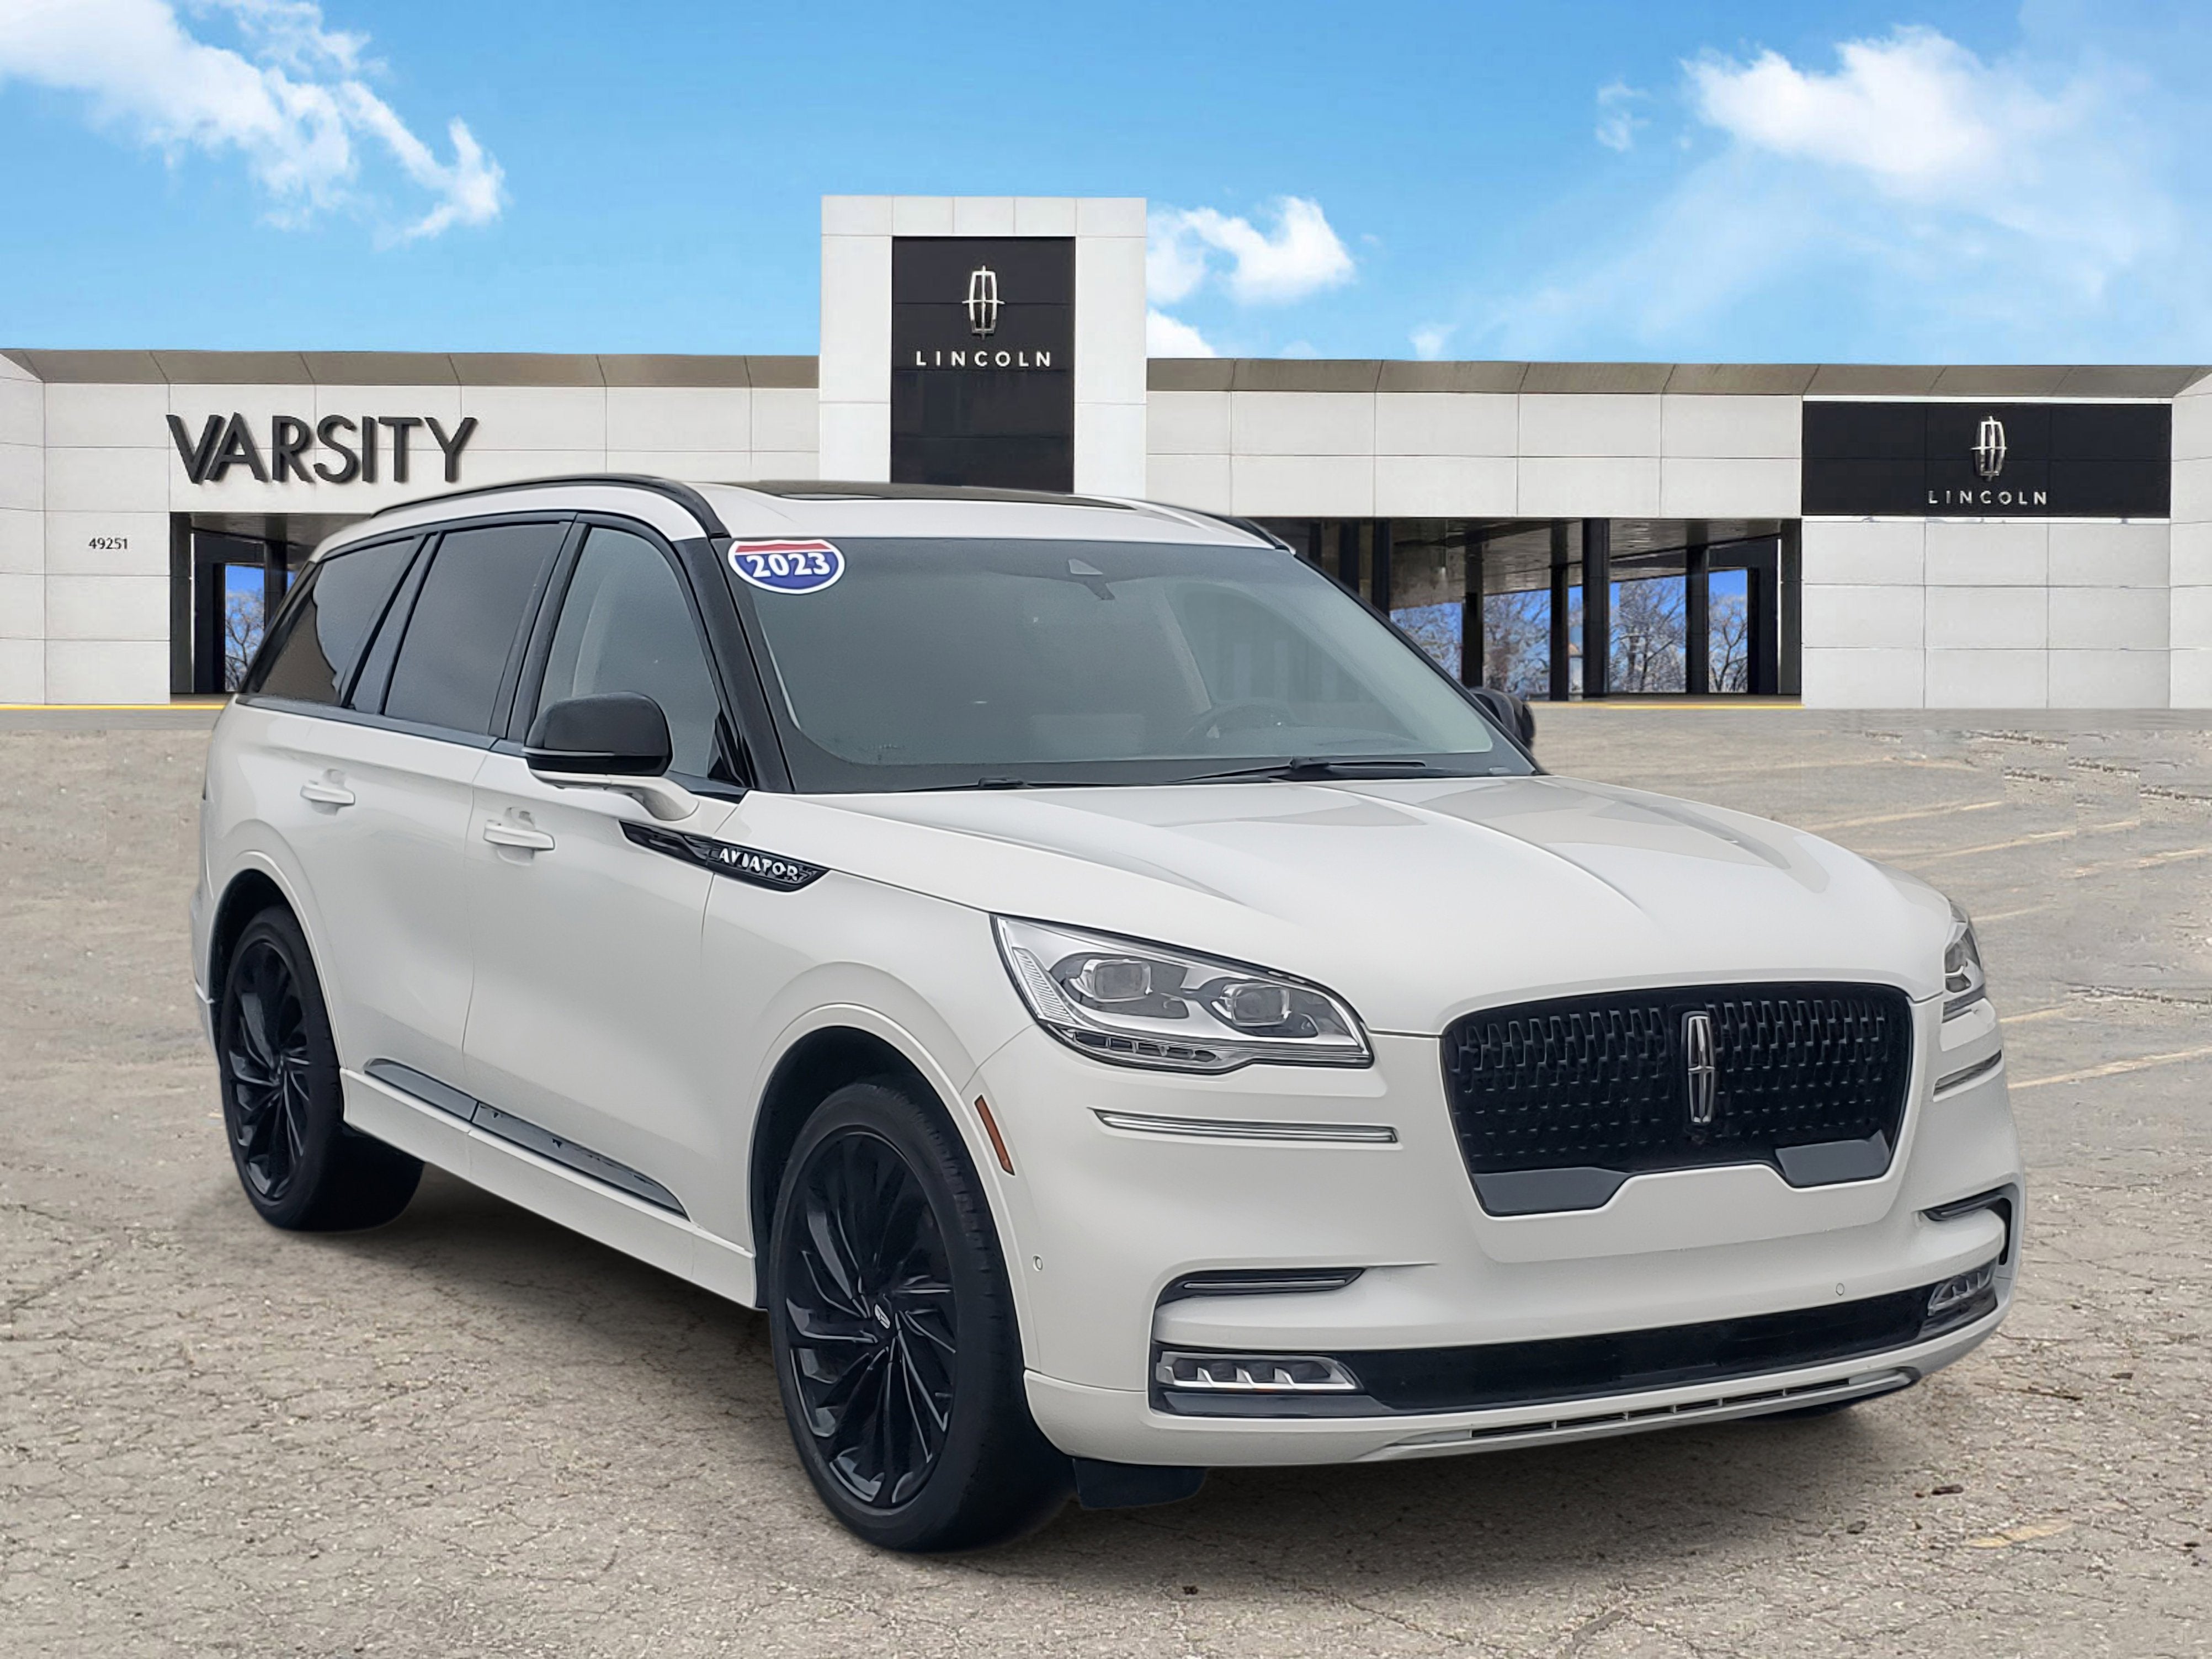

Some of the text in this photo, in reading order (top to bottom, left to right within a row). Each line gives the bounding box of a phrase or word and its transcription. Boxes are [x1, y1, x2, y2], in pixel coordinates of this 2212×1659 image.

[916, 351, 1050, 366] LINCOLN
[166, 412, 478, 484] VARSITY
[1928, 491, 2047, 505] LINCOLN
[88, 538, 127, 549] 49251
[746, 552, 830, 577] 2023
